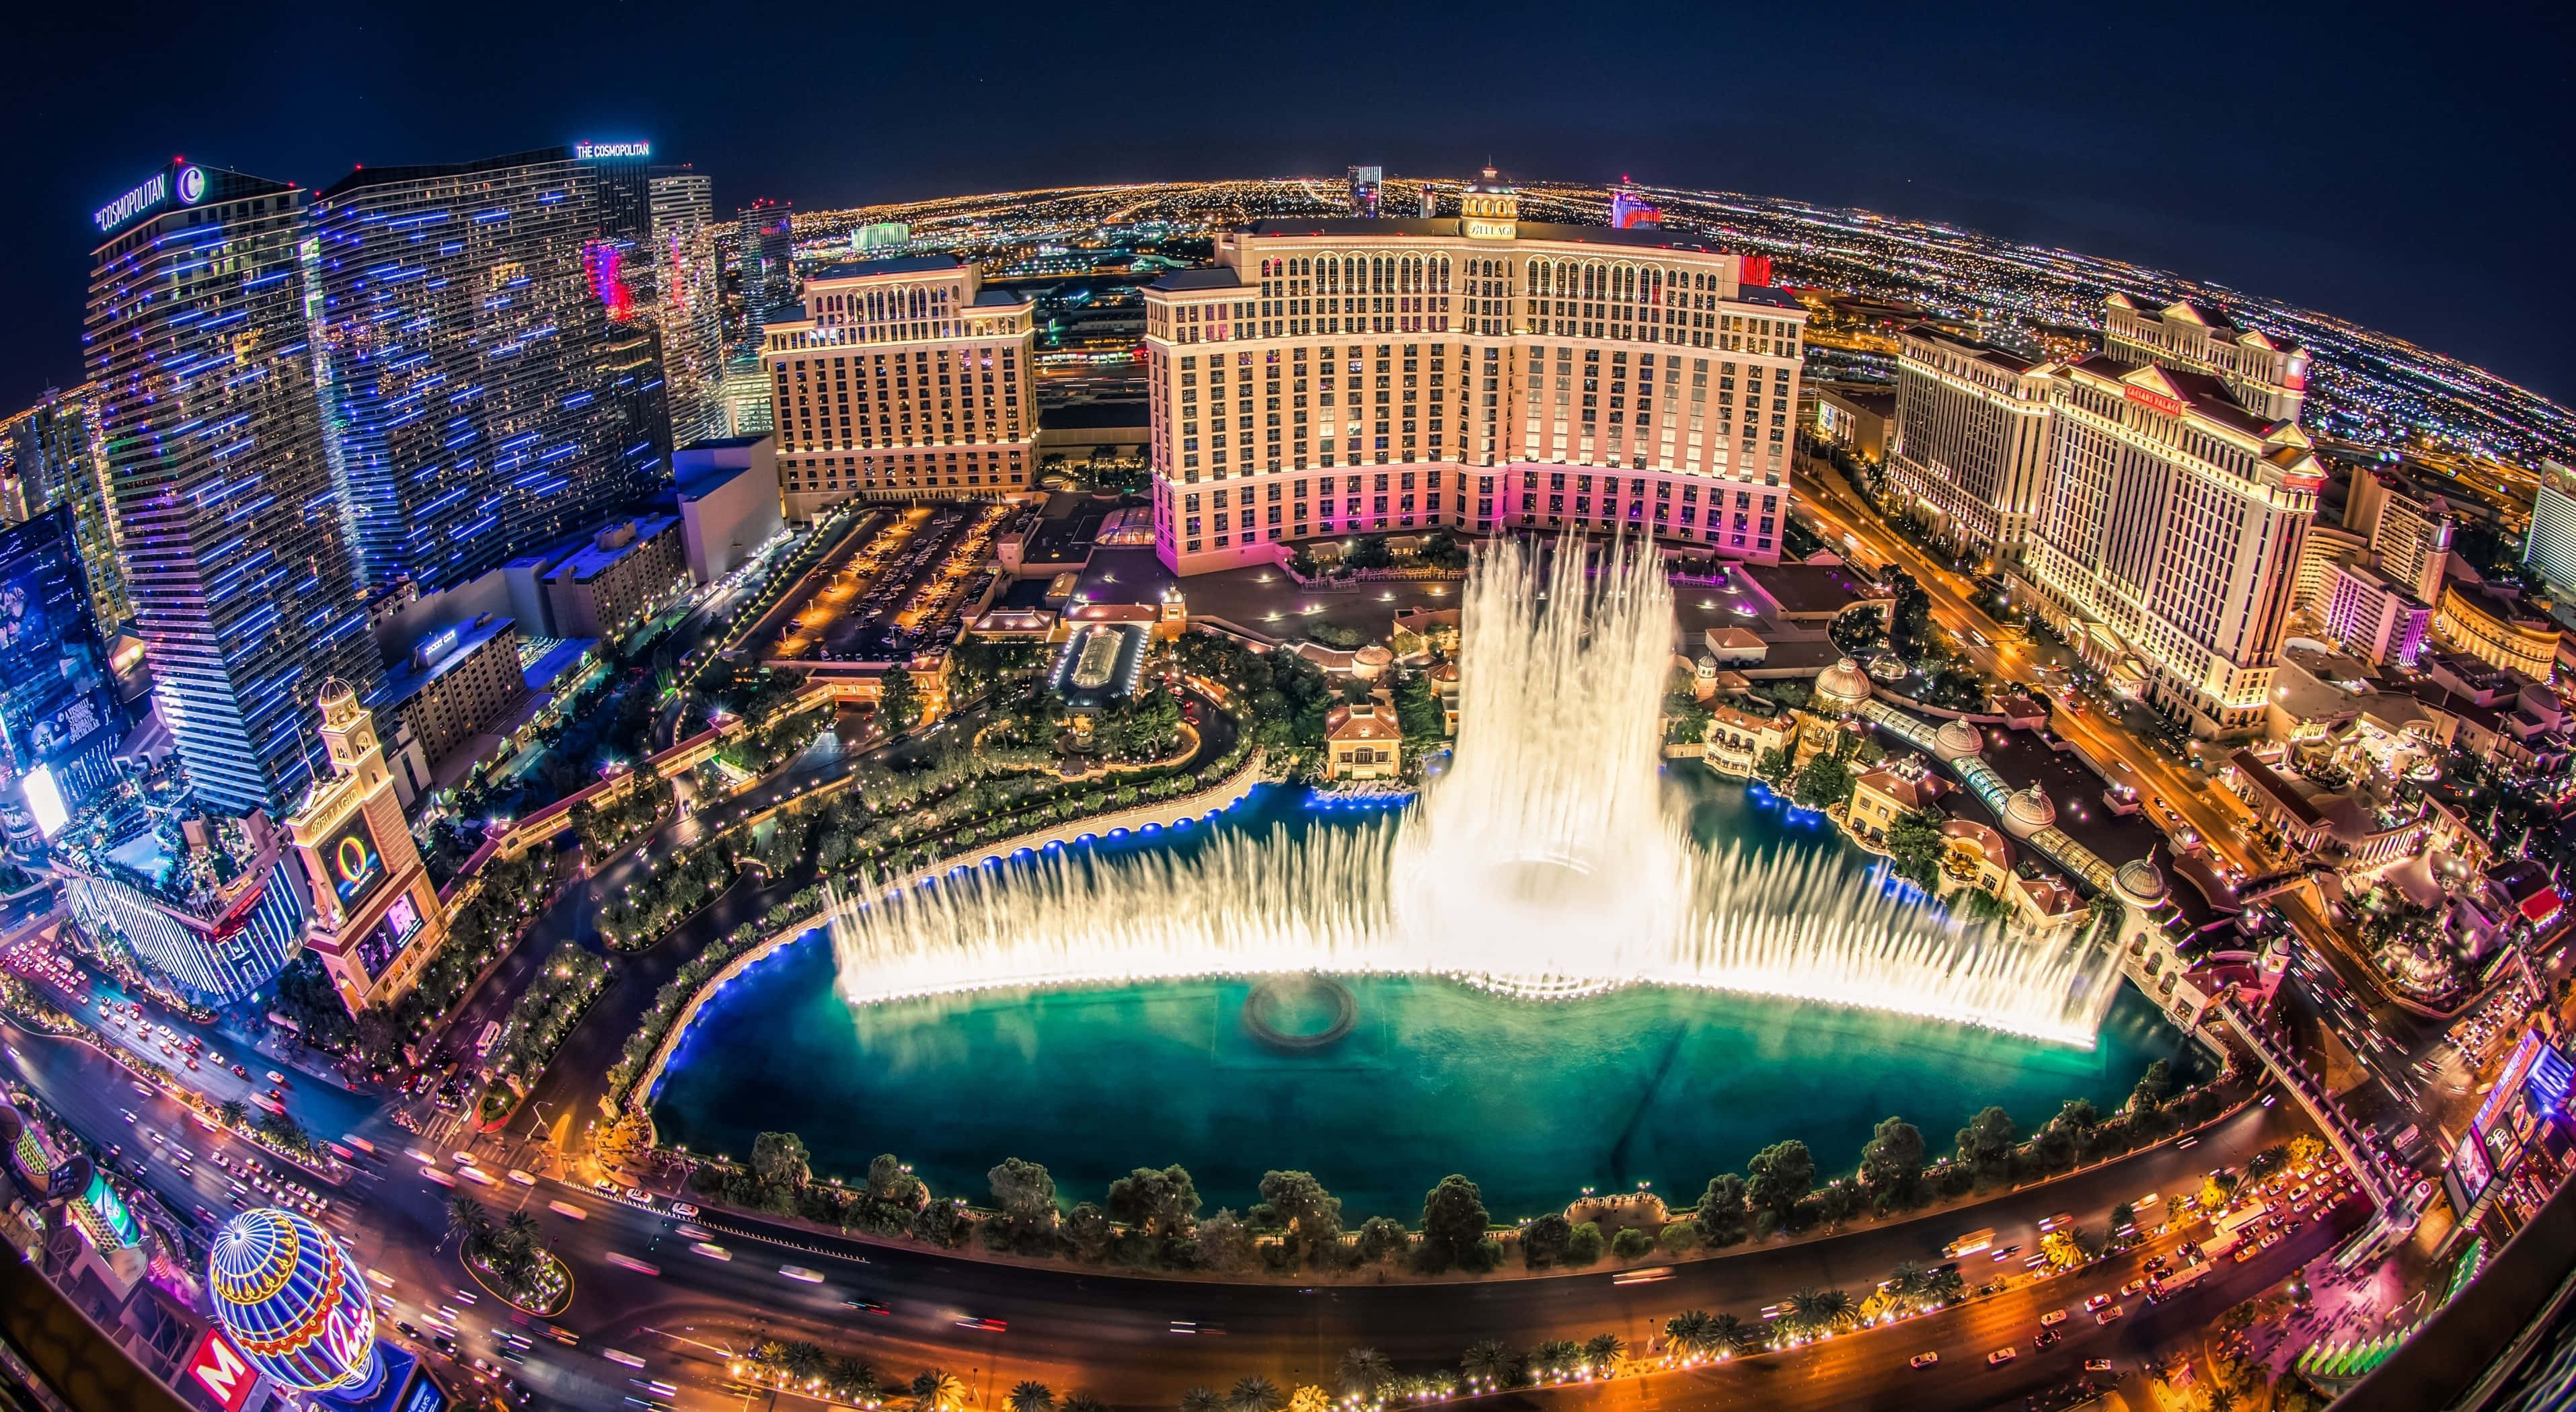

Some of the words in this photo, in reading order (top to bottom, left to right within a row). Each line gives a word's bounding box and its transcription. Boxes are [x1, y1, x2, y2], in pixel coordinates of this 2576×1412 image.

[577, 146, 593, 158] THE
[595, 144, 649, 157] COSMOPOLITAN
[102, 173, 165, 231] COSMOPOLITAN
[311, 789, 359, 838] BELLAGIO
[196, 1337, 245, 1403] M
